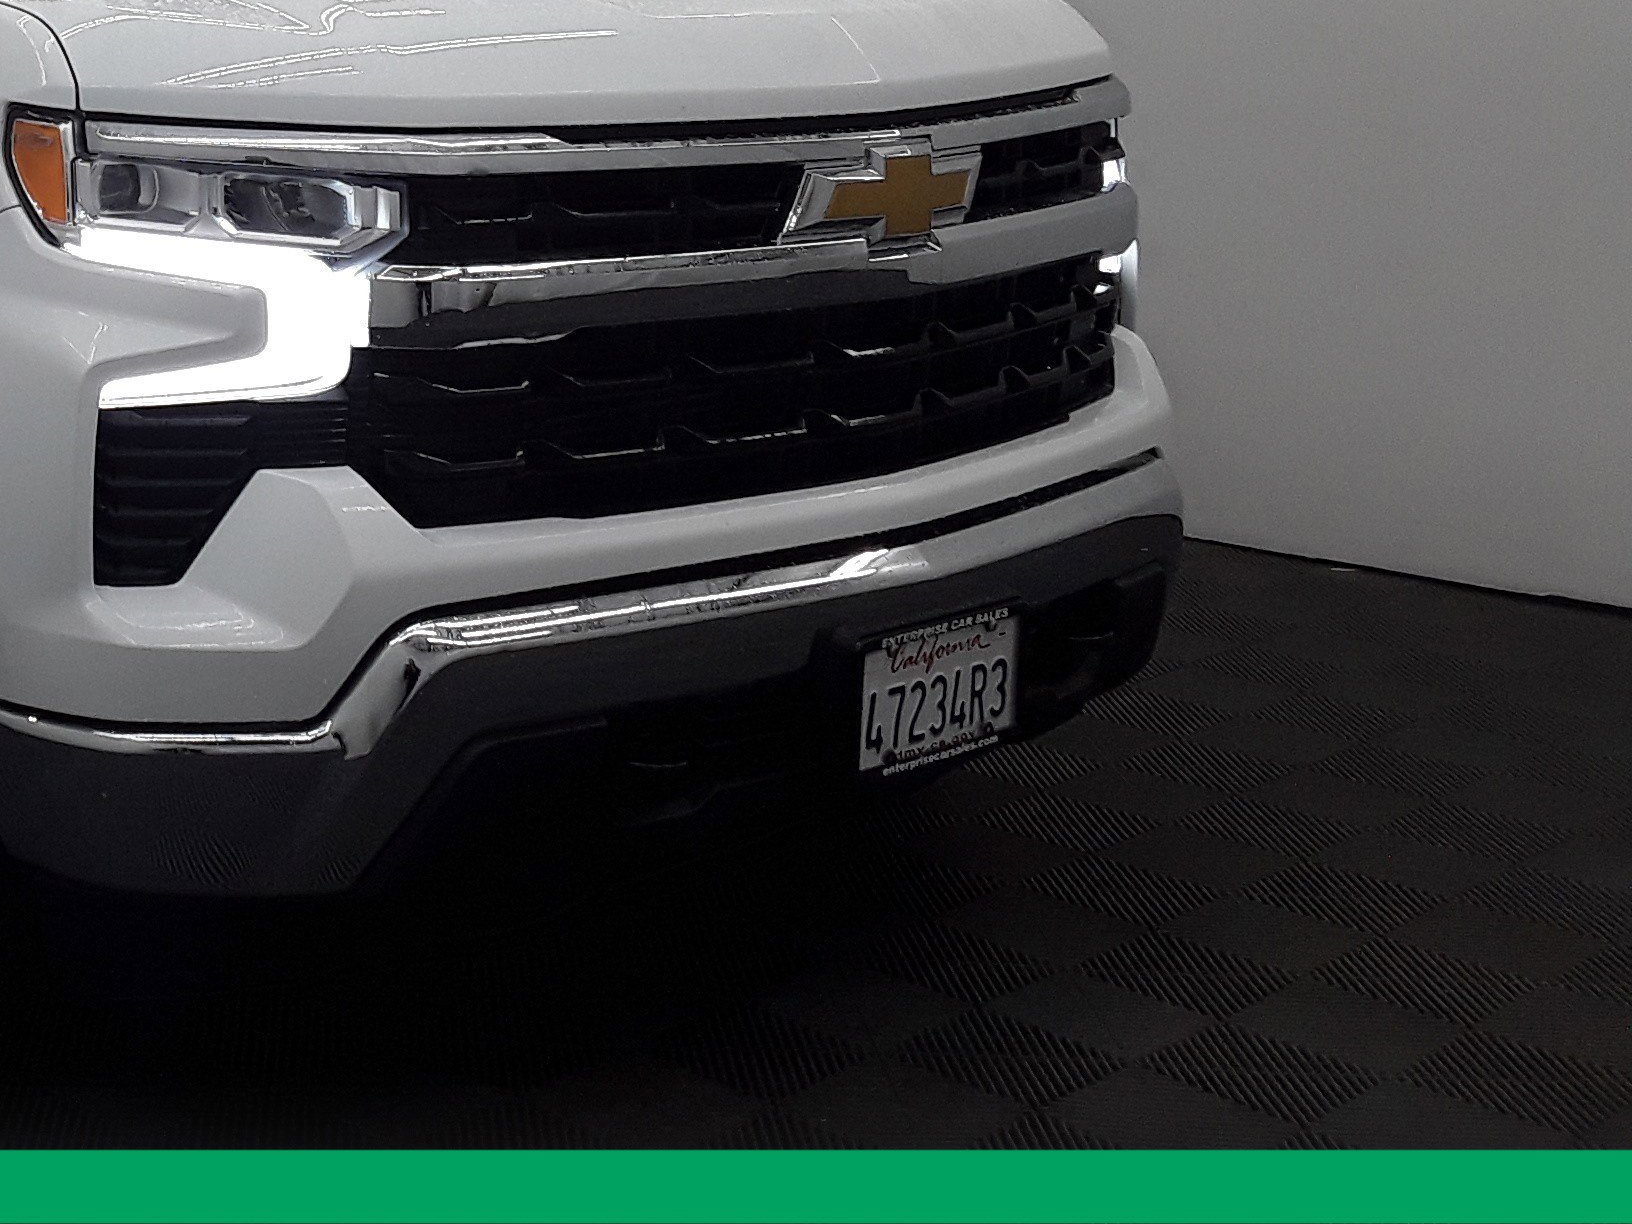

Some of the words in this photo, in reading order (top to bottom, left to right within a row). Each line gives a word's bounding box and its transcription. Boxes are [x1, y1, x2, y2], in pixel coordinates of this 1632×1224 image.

[951, 616, 974, 630] CAR
[976, 607, 1009, 624] SALES
[891, 633, 990, 673] California
[865, 658, 1007, 753] 47234R3
